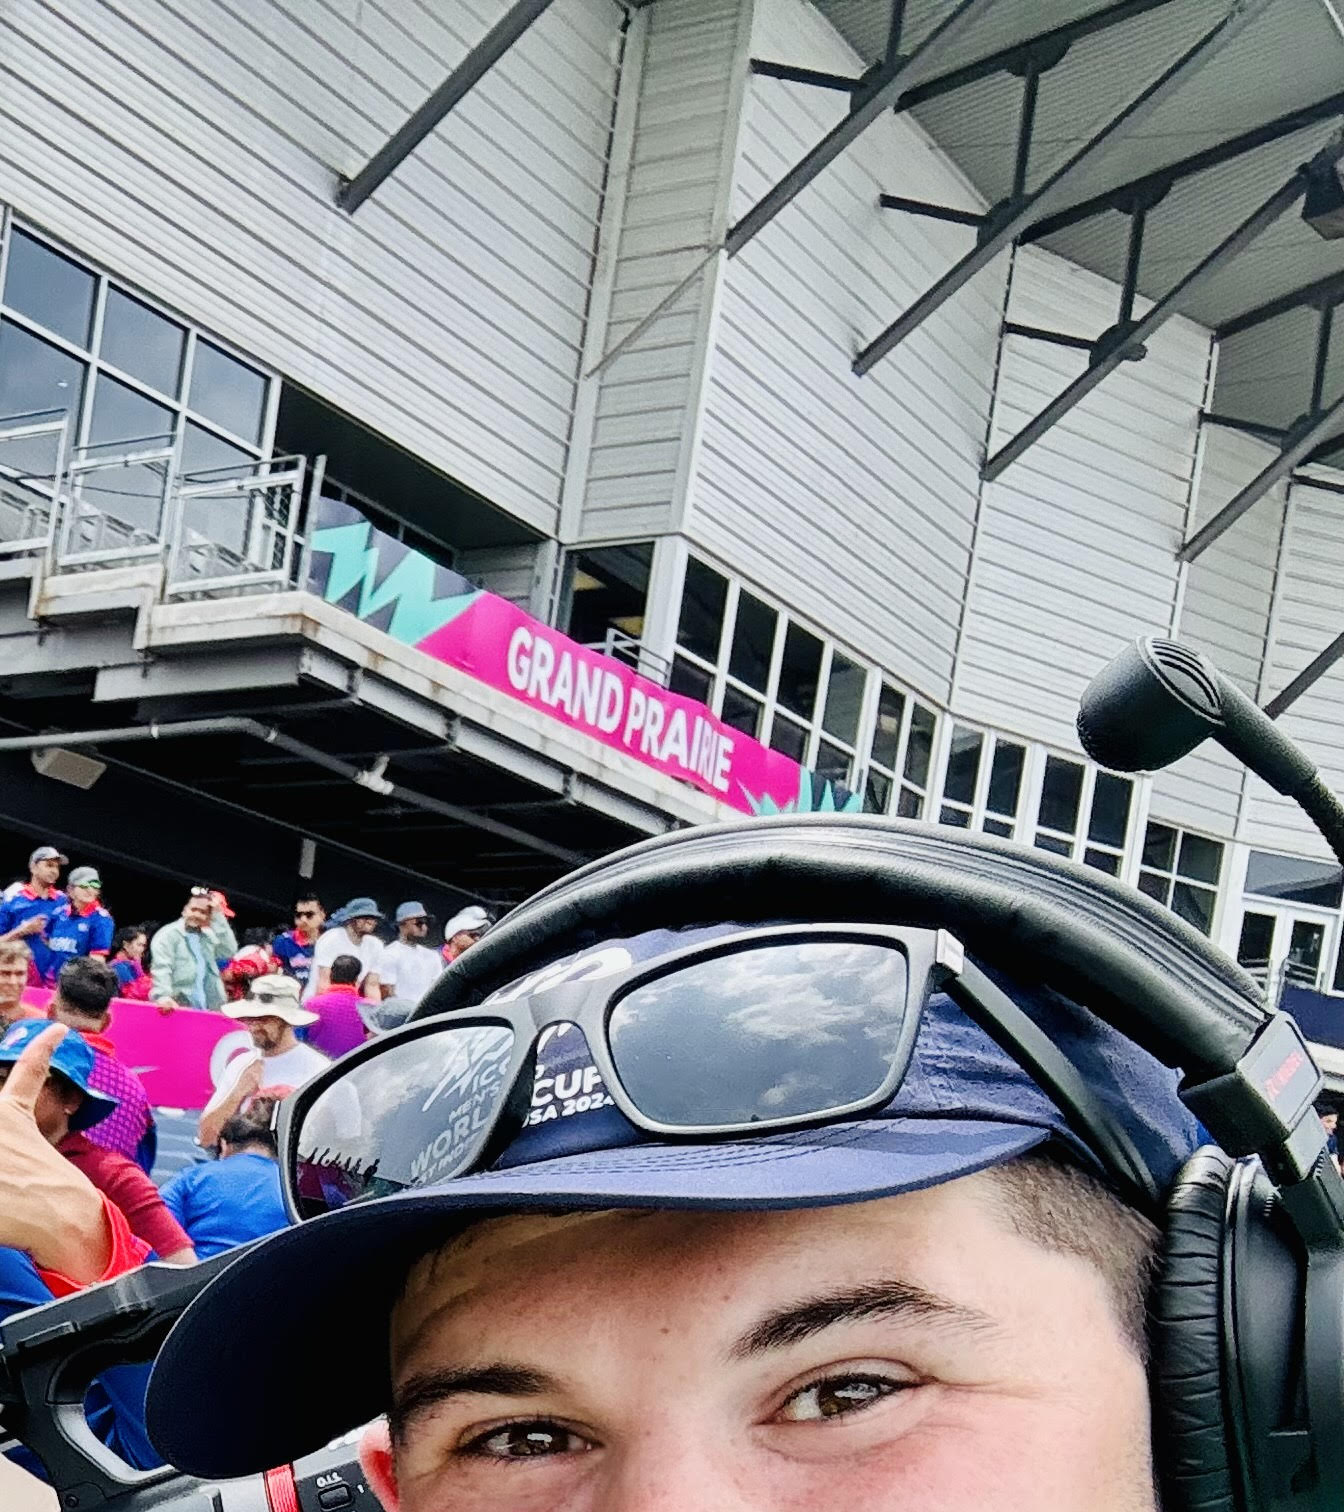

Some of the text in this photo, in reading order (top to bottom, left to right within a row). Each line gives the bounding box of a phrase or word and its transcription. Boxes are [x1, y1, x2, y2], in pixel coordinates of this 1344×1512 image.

[507, 627, 734, 792] GRAND PRAIRIE
[531, 1065, 602, 1107] CUP
[410, 1108, 490, 1179] WORL
